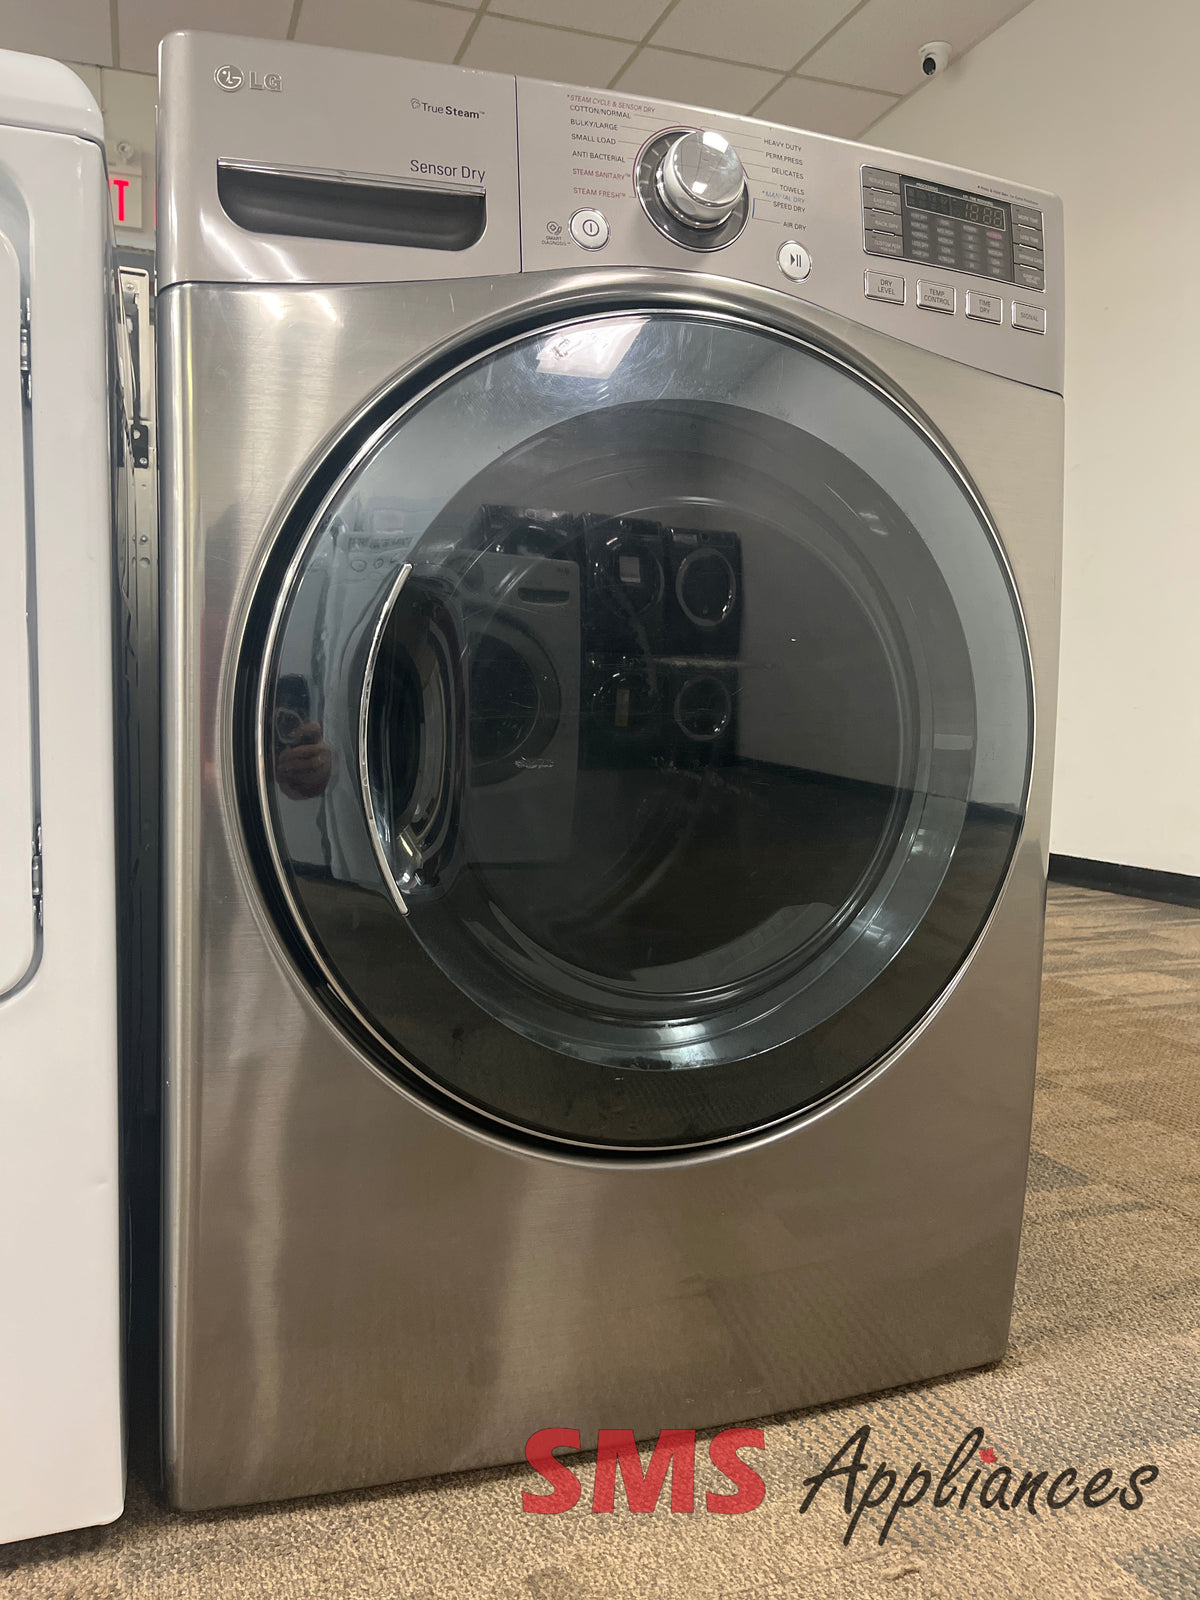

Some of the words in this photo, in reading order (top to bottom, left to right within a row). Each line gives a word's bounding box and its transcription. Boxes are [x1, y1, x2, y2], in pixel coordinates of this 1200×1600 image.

[249, 70, 282, 92] LG
[592, 98, 611, 106] CYCLE
[618, 102, 642, 111] SENSOR
[570, 104, 632, 119] COTTON/NORMAL
[570, 118, 618, 131] BULKY/LARGE
[571, 134, 595, 142] SMALL
[596, 136, 616, 145] LOAD
[764, 138, 784, 148] HEAVY
[785, 144, 802, 152] DUTY
[572, 150, 588, 158] ANTI
[590, 152, 626, 163] BACTERIAL
[784, 156, 803, 166] PRESS
[410, 160, 457, 178] Sensor
[461, 165, 486, 183] Dry
[572, 168, 594, 176] STEAM
[772, 167, 804, 180] DELICATES
[573, 187, 598, 196] STEAM
[780, 185, 805, 196] TOWELS
[112, 179, 130, 221] T
[773, 201, 792, 211] SPEED
[880, 278, 892, 287] DRY
[878, 286, 896, 295] LEVEL
[924, 294, 950, 306] CONTROL
[978, 300, 991, 308] TIME
[980, 306, 990, 314] DRY
[1020, 312, 1038, 322] SIGNAL
